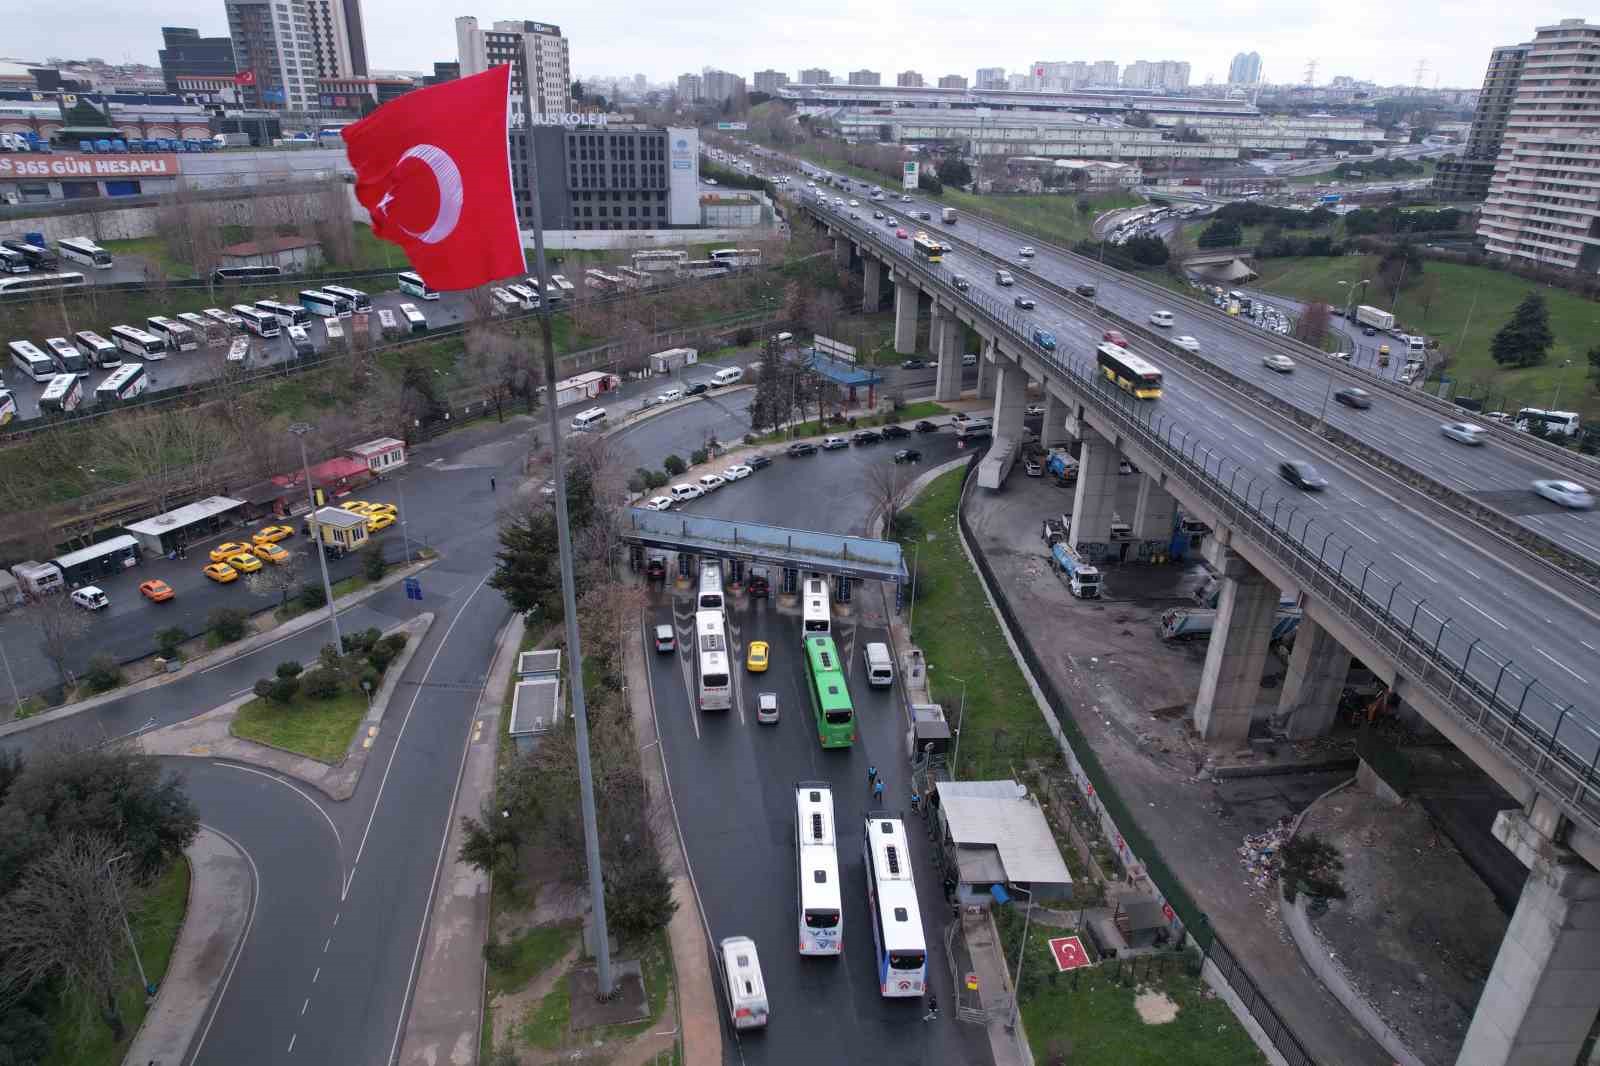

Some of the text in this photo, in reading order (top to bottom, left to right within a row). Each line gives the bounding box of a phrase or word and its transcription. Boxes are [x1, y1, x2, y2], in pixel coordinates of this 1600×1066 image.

[15, 160, 49, 174] 365
[51, 157, 91, 173] GÜN
[95, 159, 166, 173] HESAPLI
